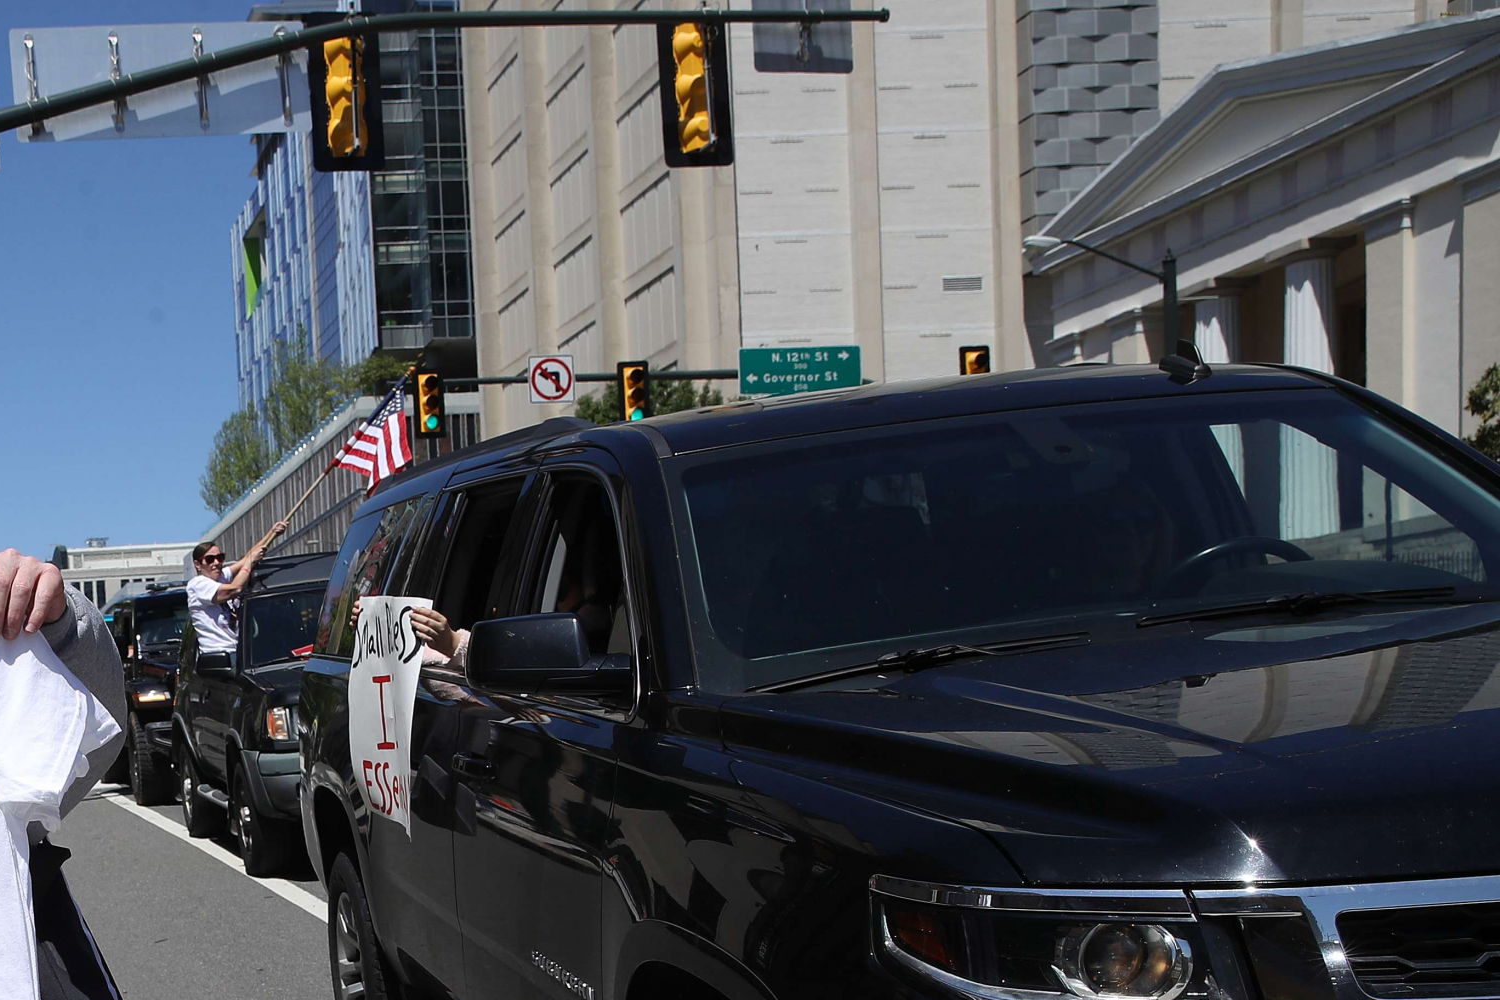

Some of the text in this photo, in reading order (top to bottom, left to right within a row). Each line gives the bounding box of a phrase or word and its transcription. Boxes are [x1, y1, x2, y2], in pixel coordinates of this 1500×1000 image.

[771, 351, 829, 363] N. 12th St
[763, 371, 838, 383] Governor St
